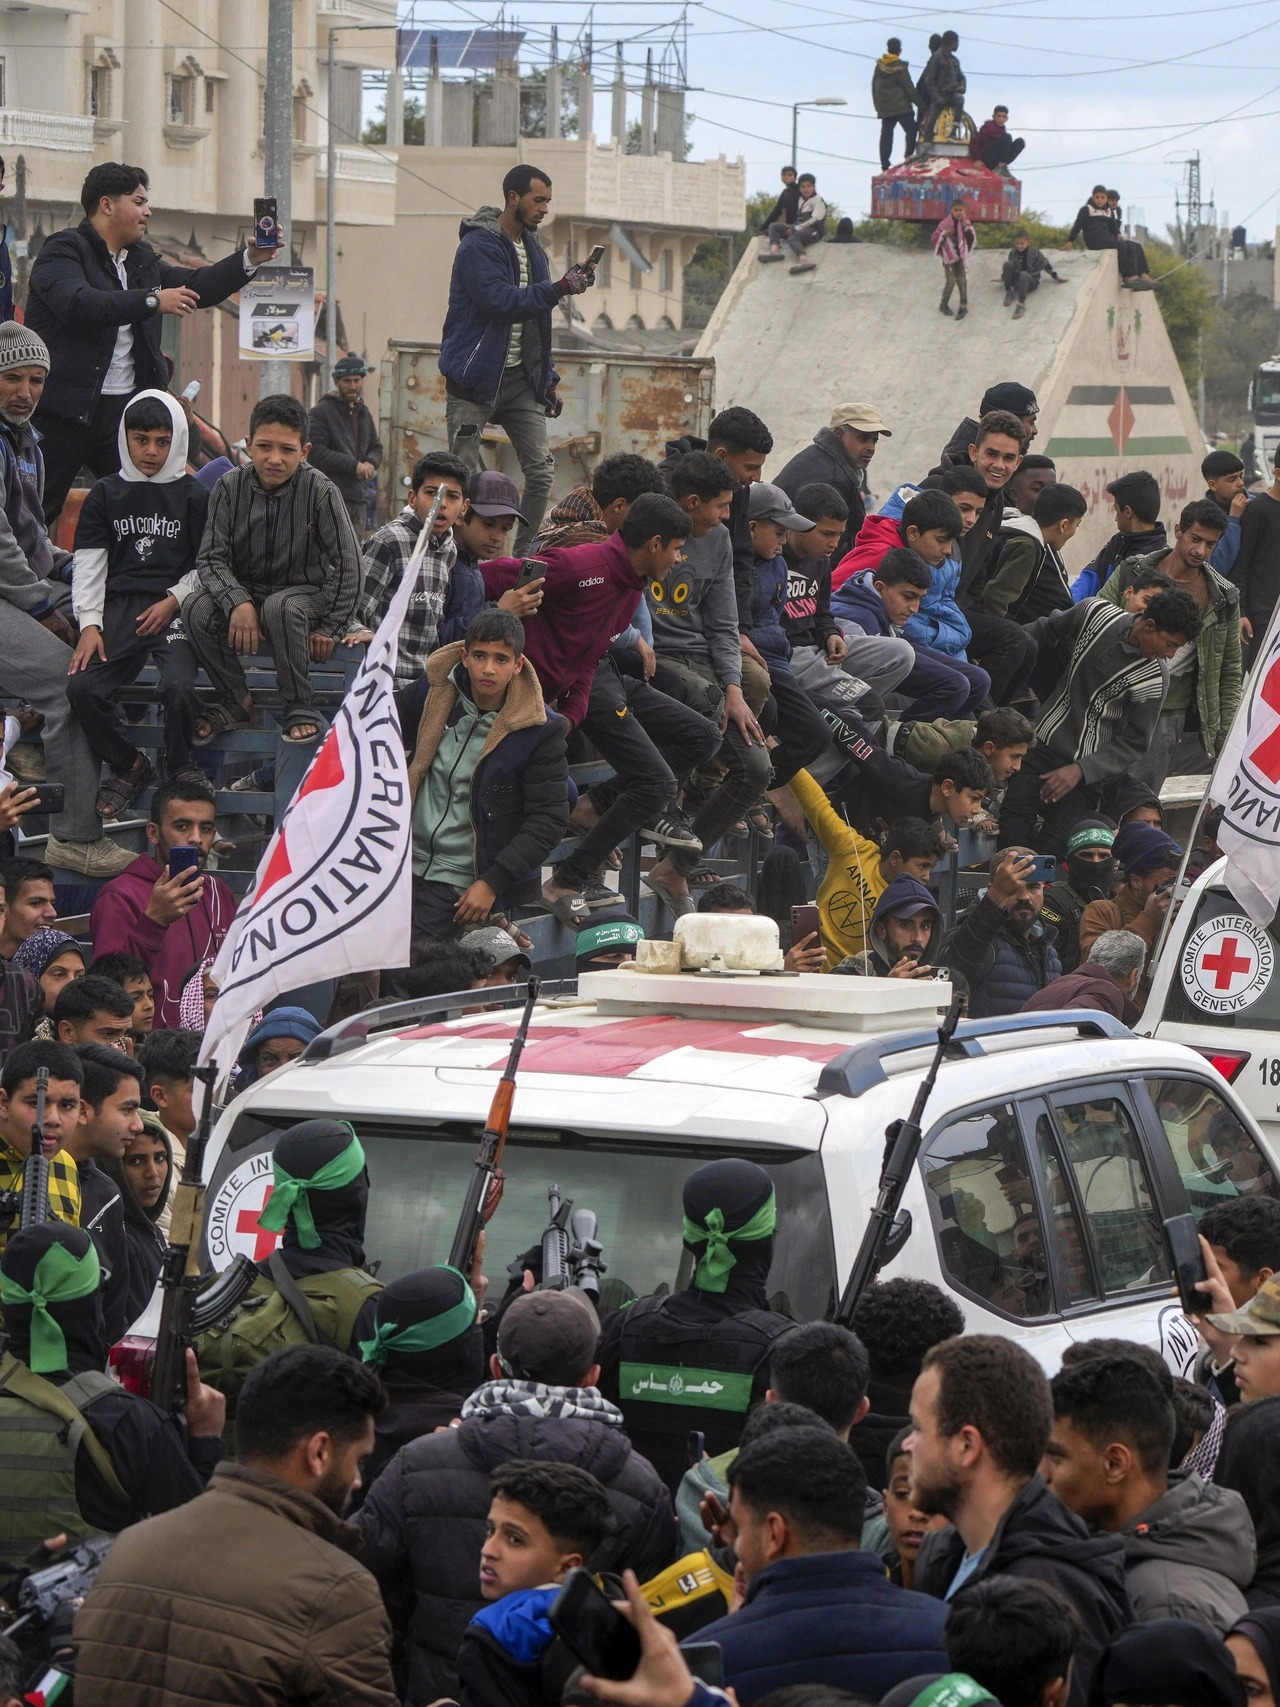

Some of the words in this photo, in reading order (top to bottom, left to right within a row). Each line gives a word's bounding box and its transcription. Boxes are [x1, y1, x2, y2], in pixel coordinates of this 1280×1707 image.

[579, 577, 604, 588] adidas
[230, 660, 405, 974] INTERNATIONA
[847, 865, 877, 909] ANNA
[1183, 930, 1207, 985] COMITE
[1211, 917, 1272, 992] INTERNATIONAL
[1193, 990, 1248, 1011] GENEVE
[211, 1174, 243, 1256] COMITE
